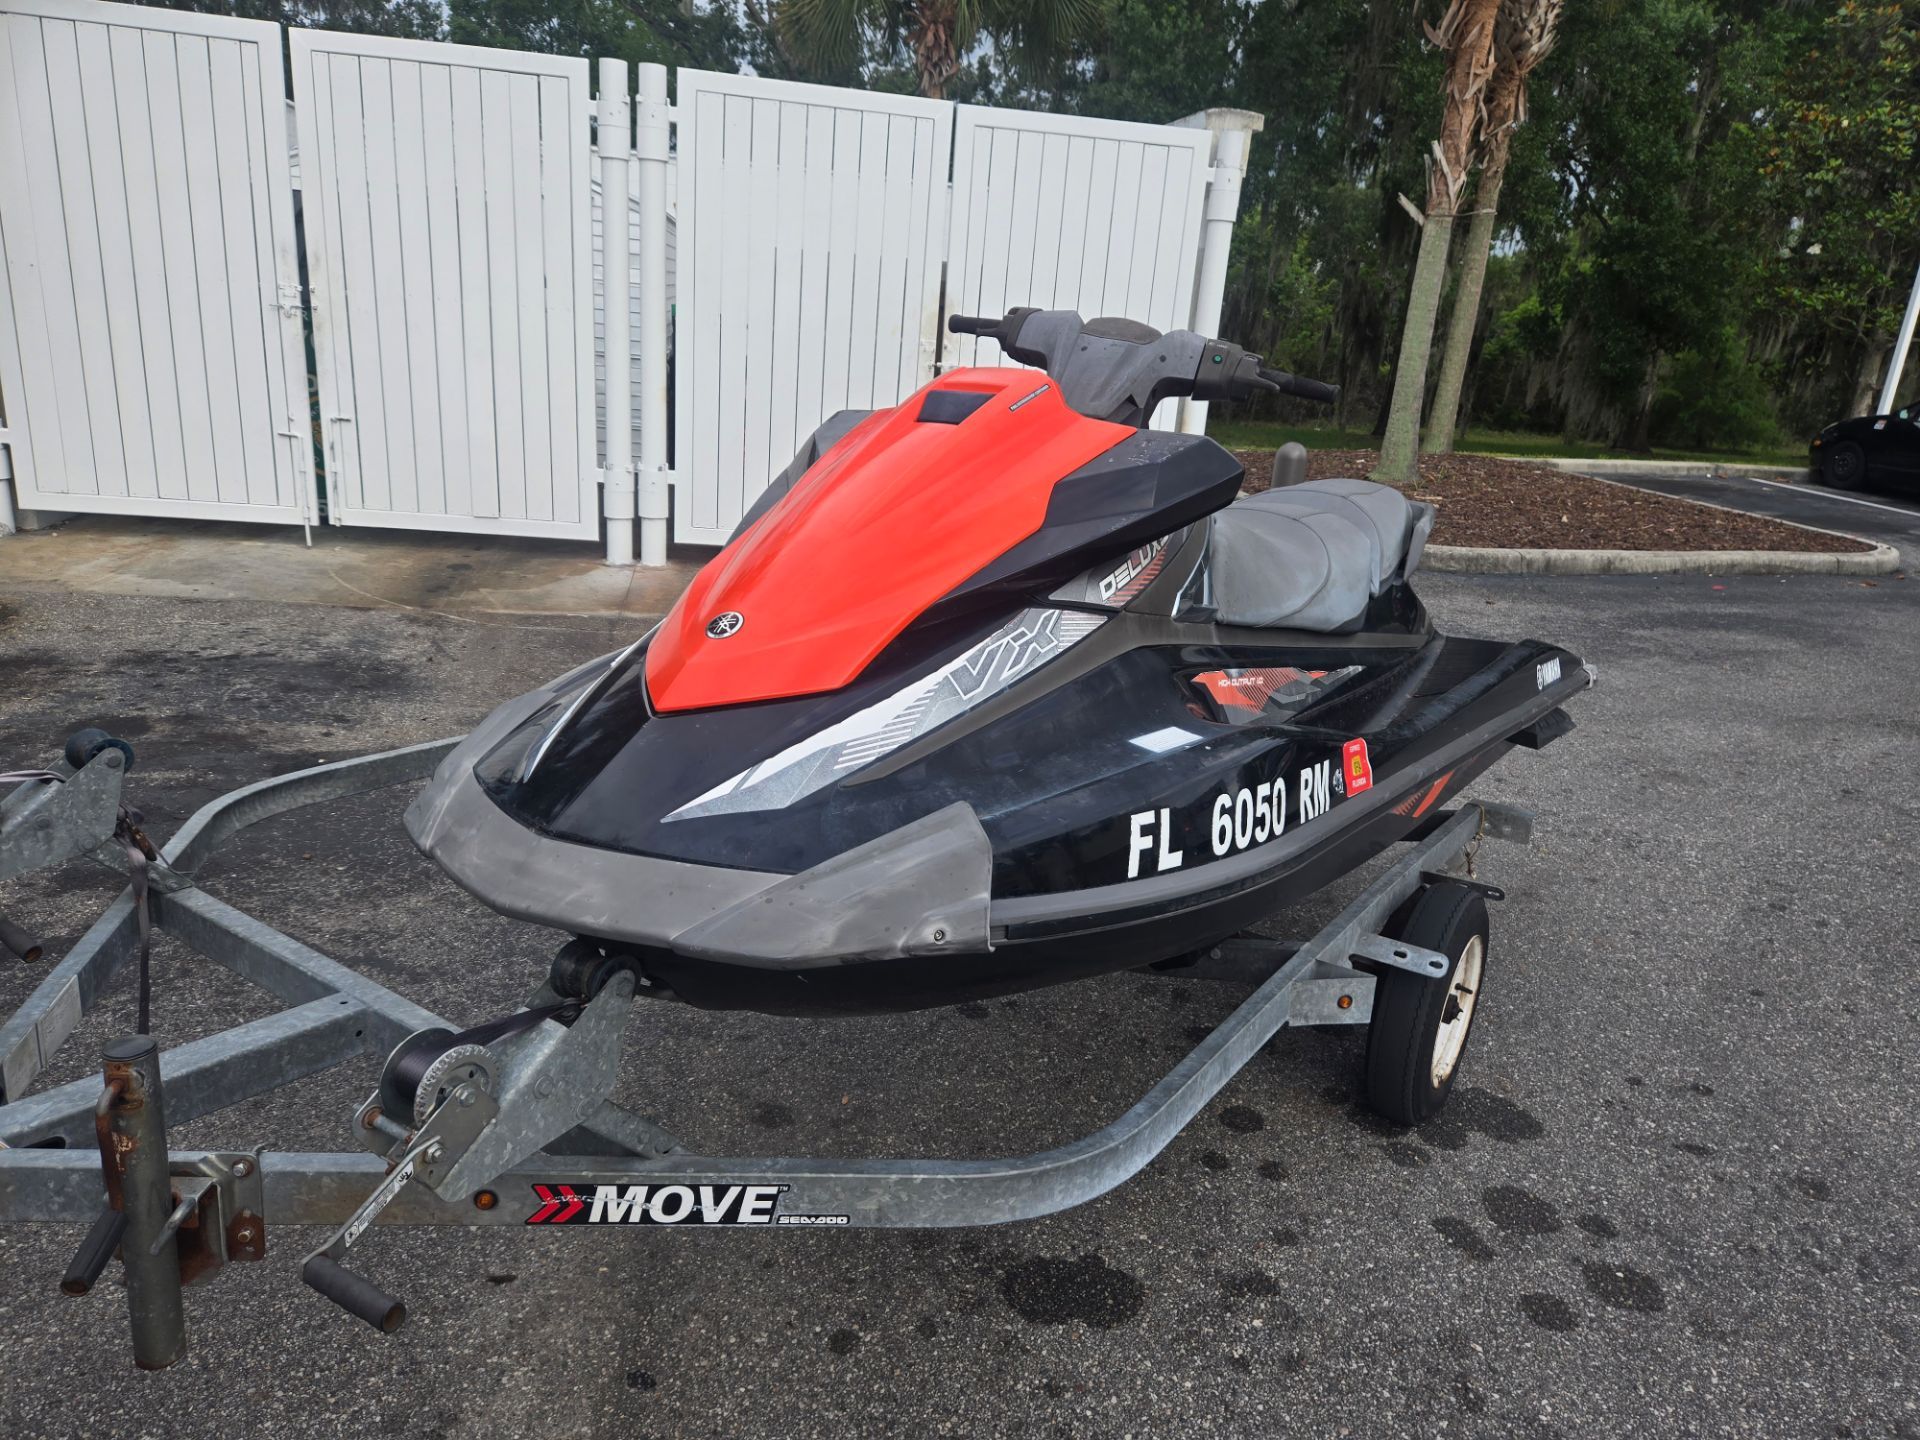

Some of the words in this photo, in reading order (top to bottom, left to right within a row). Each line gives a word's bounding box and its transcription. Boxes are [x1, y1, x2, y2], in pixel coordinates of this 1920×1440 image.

[1099, 535, 1169, 600] DELUX
[947, 609, 1058, 700] VX
[1127, 807, 1184, 879] FL
[1212, 776, 1287, 857] 6050
[1300, 759, 1331, 824] RM
[588, 1185, 779, 1223] MOVE
